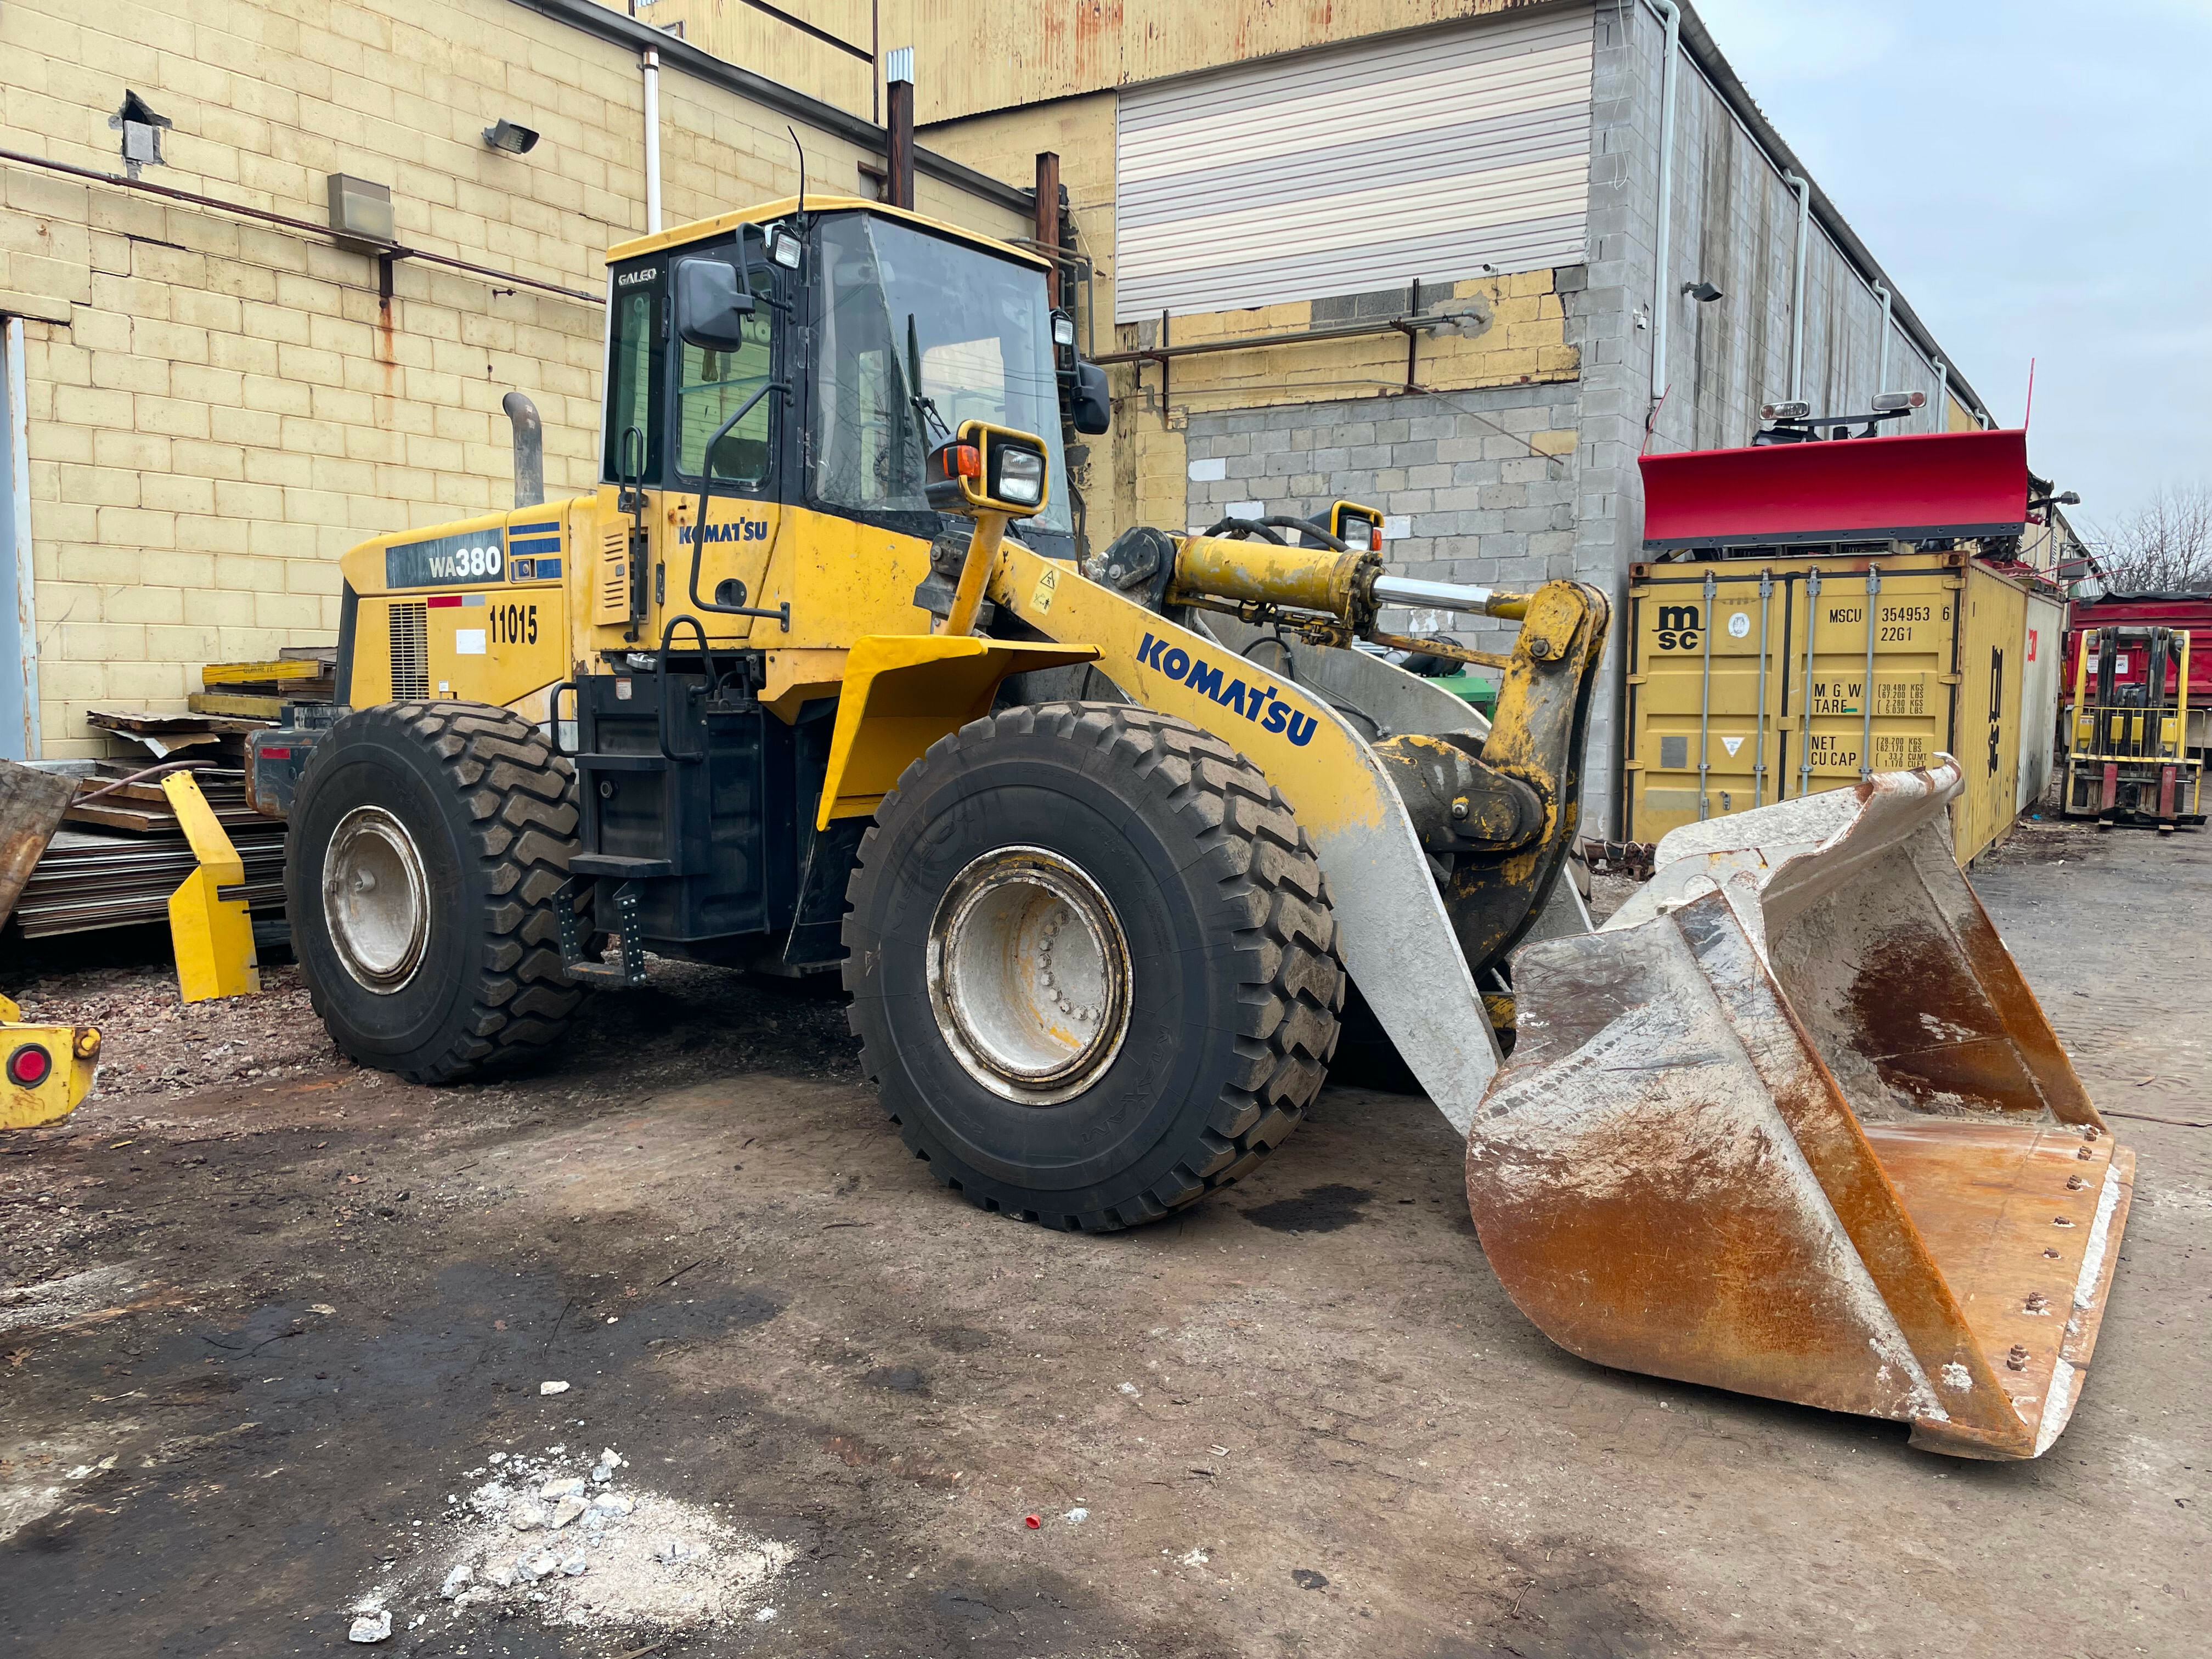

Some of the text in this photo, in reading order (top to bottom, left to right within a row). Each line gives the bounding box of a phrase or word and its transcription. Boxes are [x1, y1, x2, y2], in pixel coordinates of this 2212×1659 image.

[618, 268, 657, 286] GALEO
[429, 546, 501, 578] WA380
[1829, 607, 1950, 623] MSCU 354953 6
[490, 604, 538, 645] 11015
[1881, 627, 1912, 641] 22G1
[1136, 632, 1318, 747] KOMATSU
[1814, 699, 1847, 713] TARE
[1812, 736, 1836, 750] NET
[1881, 737, 1904, 745] 28.200
